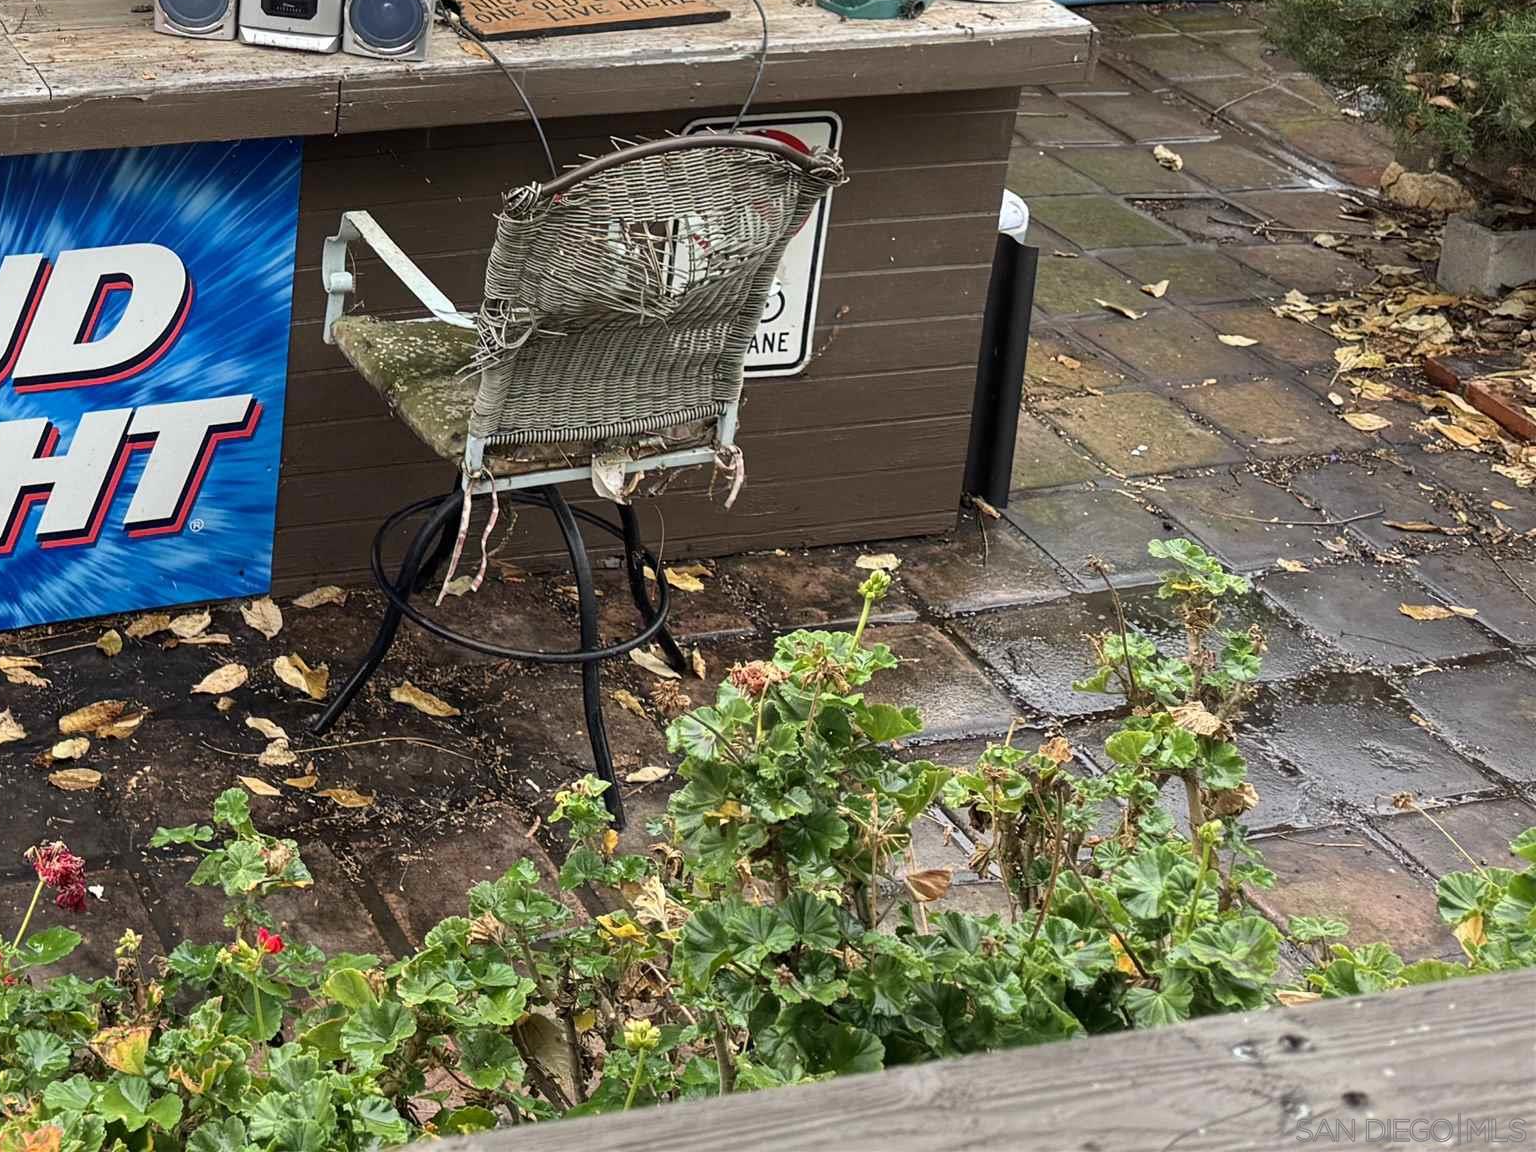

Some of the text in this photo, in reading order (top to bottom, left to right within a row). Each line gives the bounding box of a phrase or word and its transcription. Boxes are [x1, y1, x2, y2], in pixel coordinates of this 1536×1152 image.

[475, 5, 525, 24] ONE
[545, 3, 611, 23] LIVE
[746, 332, 790, 355] ANE
